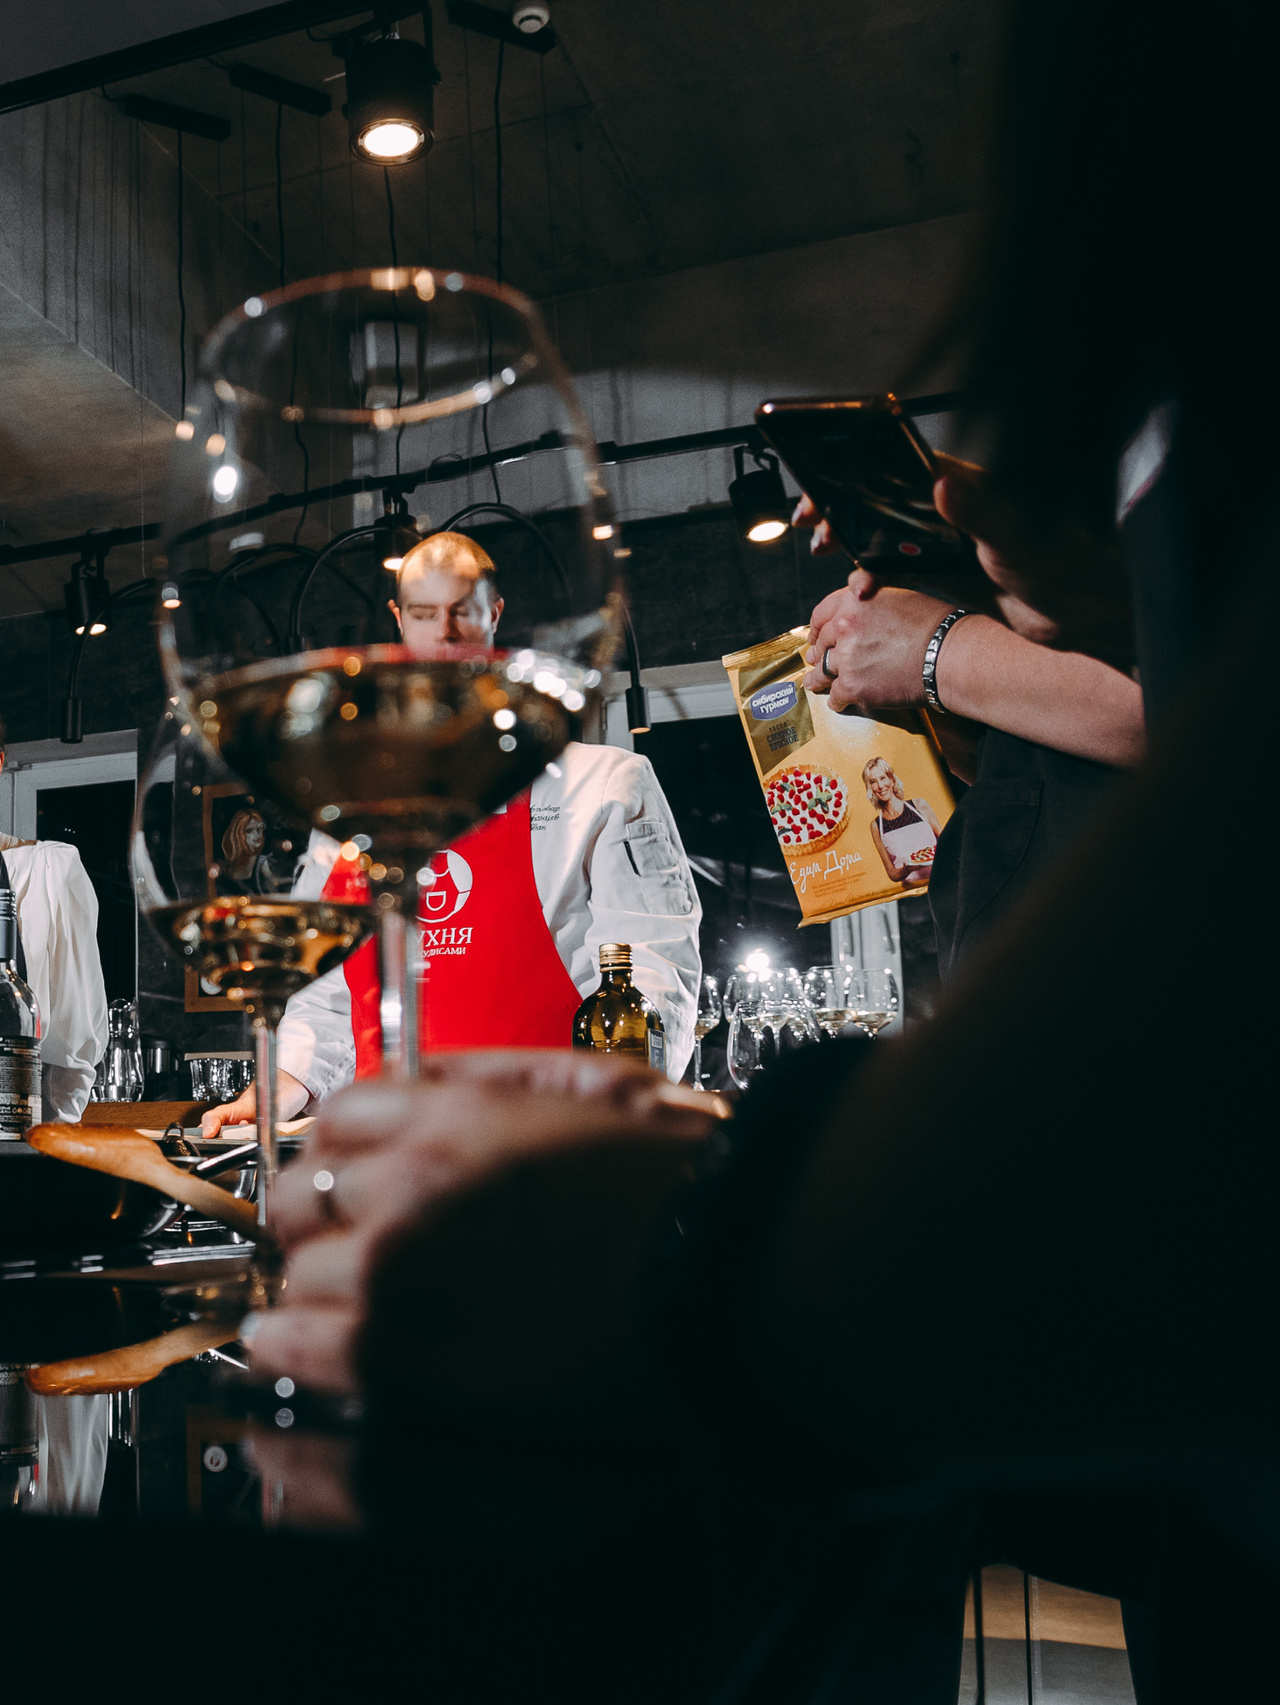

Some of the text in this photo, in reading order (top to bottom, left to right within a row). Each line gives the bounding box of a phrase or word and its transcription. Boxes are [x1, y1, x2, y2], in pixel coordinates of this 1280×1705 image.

[752, 684, 794, 707] сибирский
[760, 697, 790, 713] гурман
[789, 862, 822, 893] Едим
[823, 850, 862, 880] Дома
